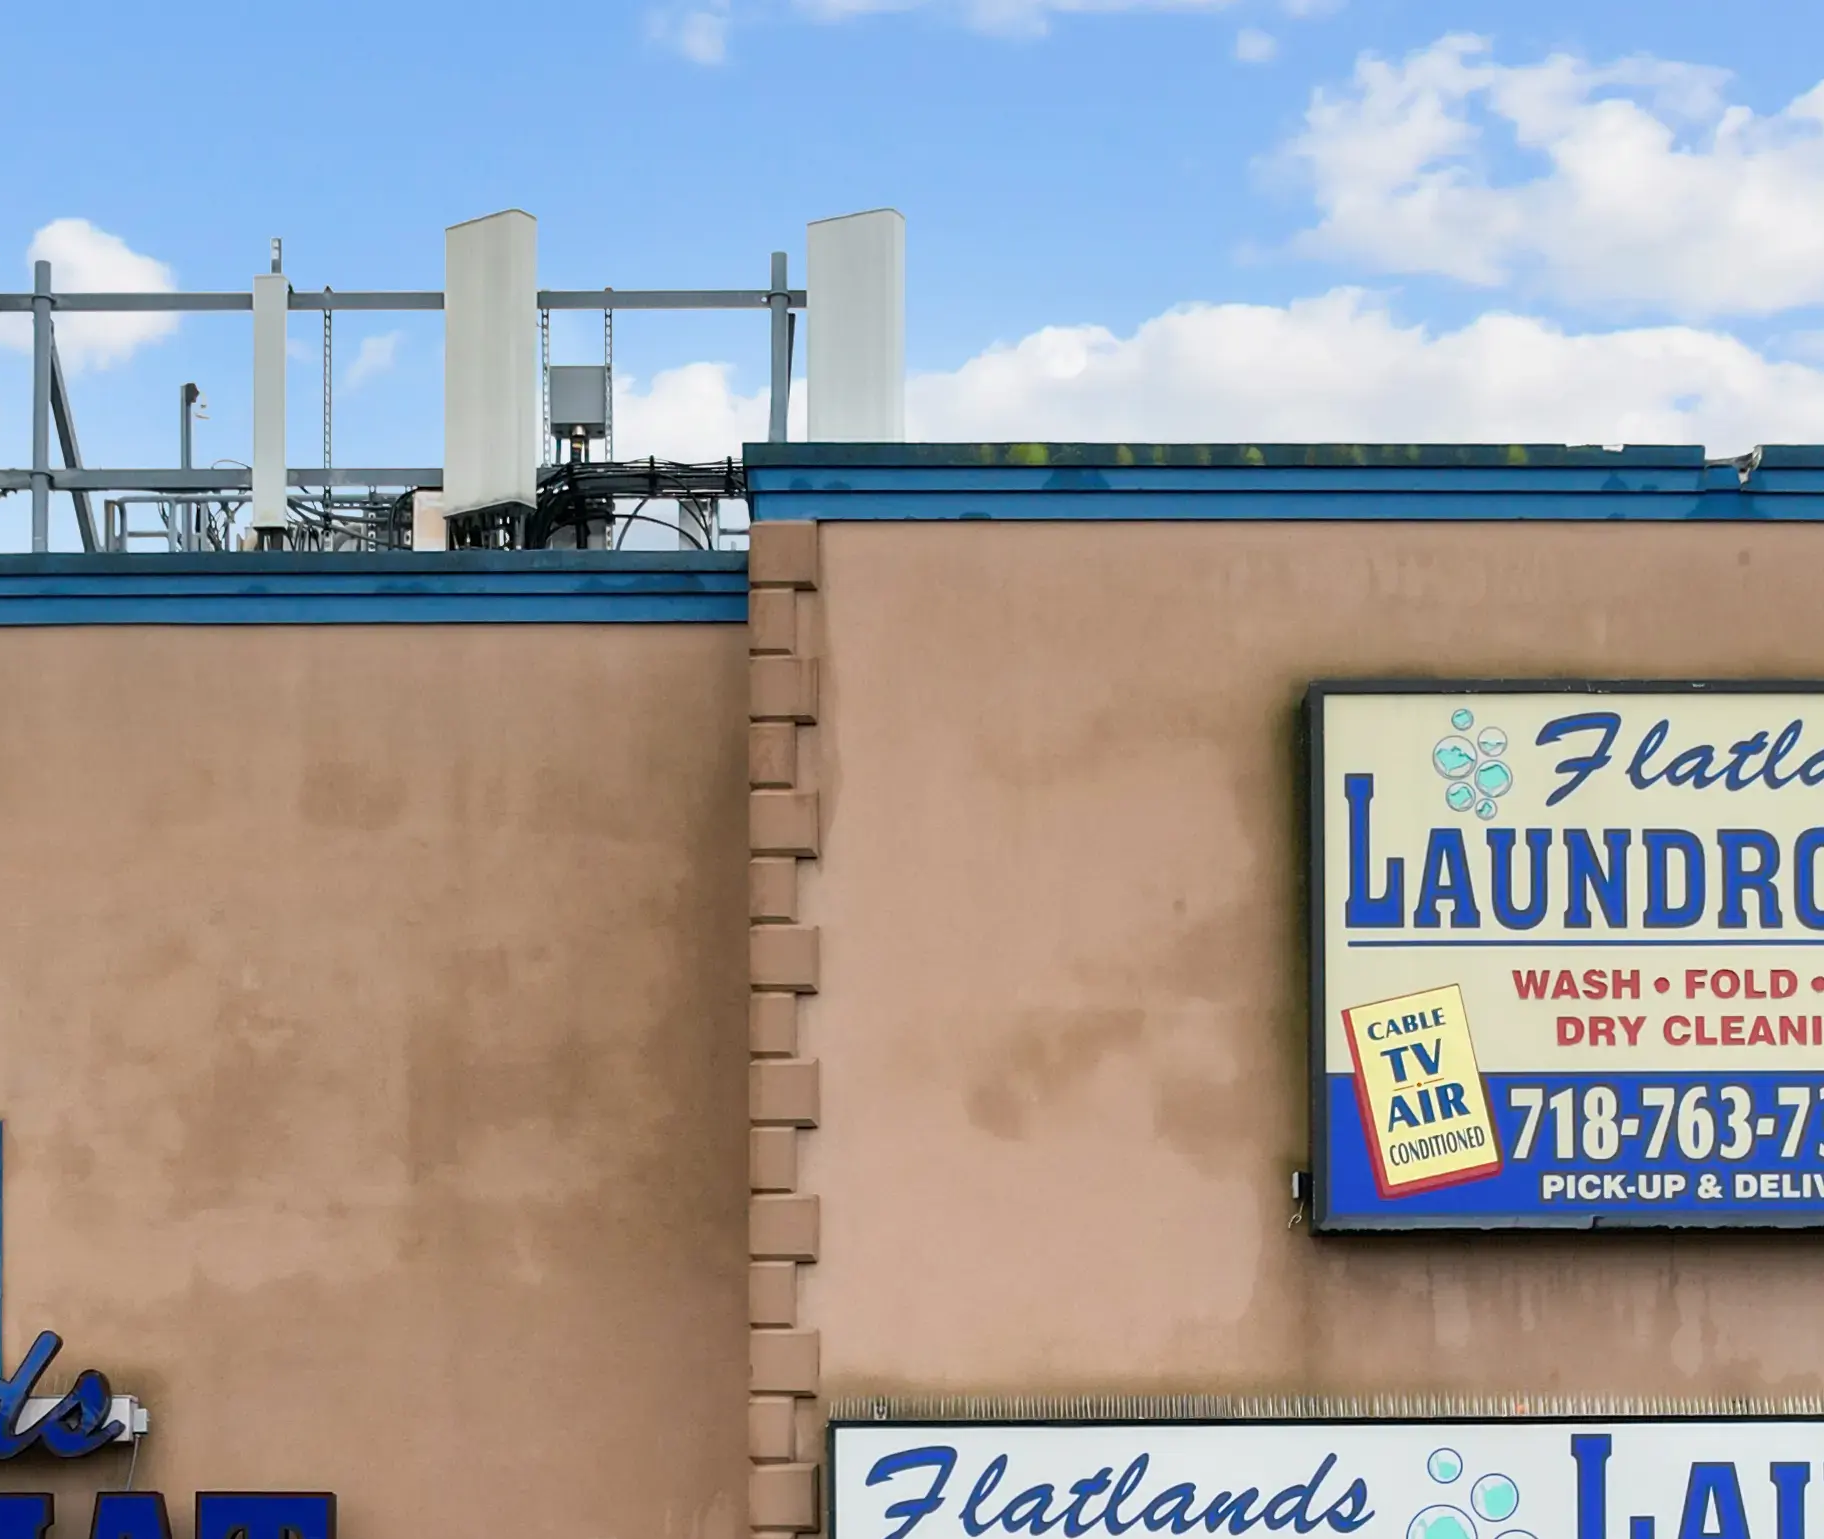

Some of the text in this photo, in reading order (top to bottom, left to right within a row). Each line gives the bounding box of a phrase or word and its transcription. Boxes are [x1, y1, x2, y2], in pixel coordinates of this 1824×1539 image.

[1512, 969, 1641, 1000] WASH
[1684, 969, 1799, 1000] FOLD
[1367, 1006, 1447, 1041] CABLE
[1556, 1015, 1647, 1046] DRY
[1379, 1040, 1444, 1084] TV
[1387, 1080, 1471, 1133] AIR
[1389, 1125, 1486, 1167] CONDITIONED
[1541, 1173, 1686, 1200] PICK-UP
[1698, 1173, 1723, 1199] &
